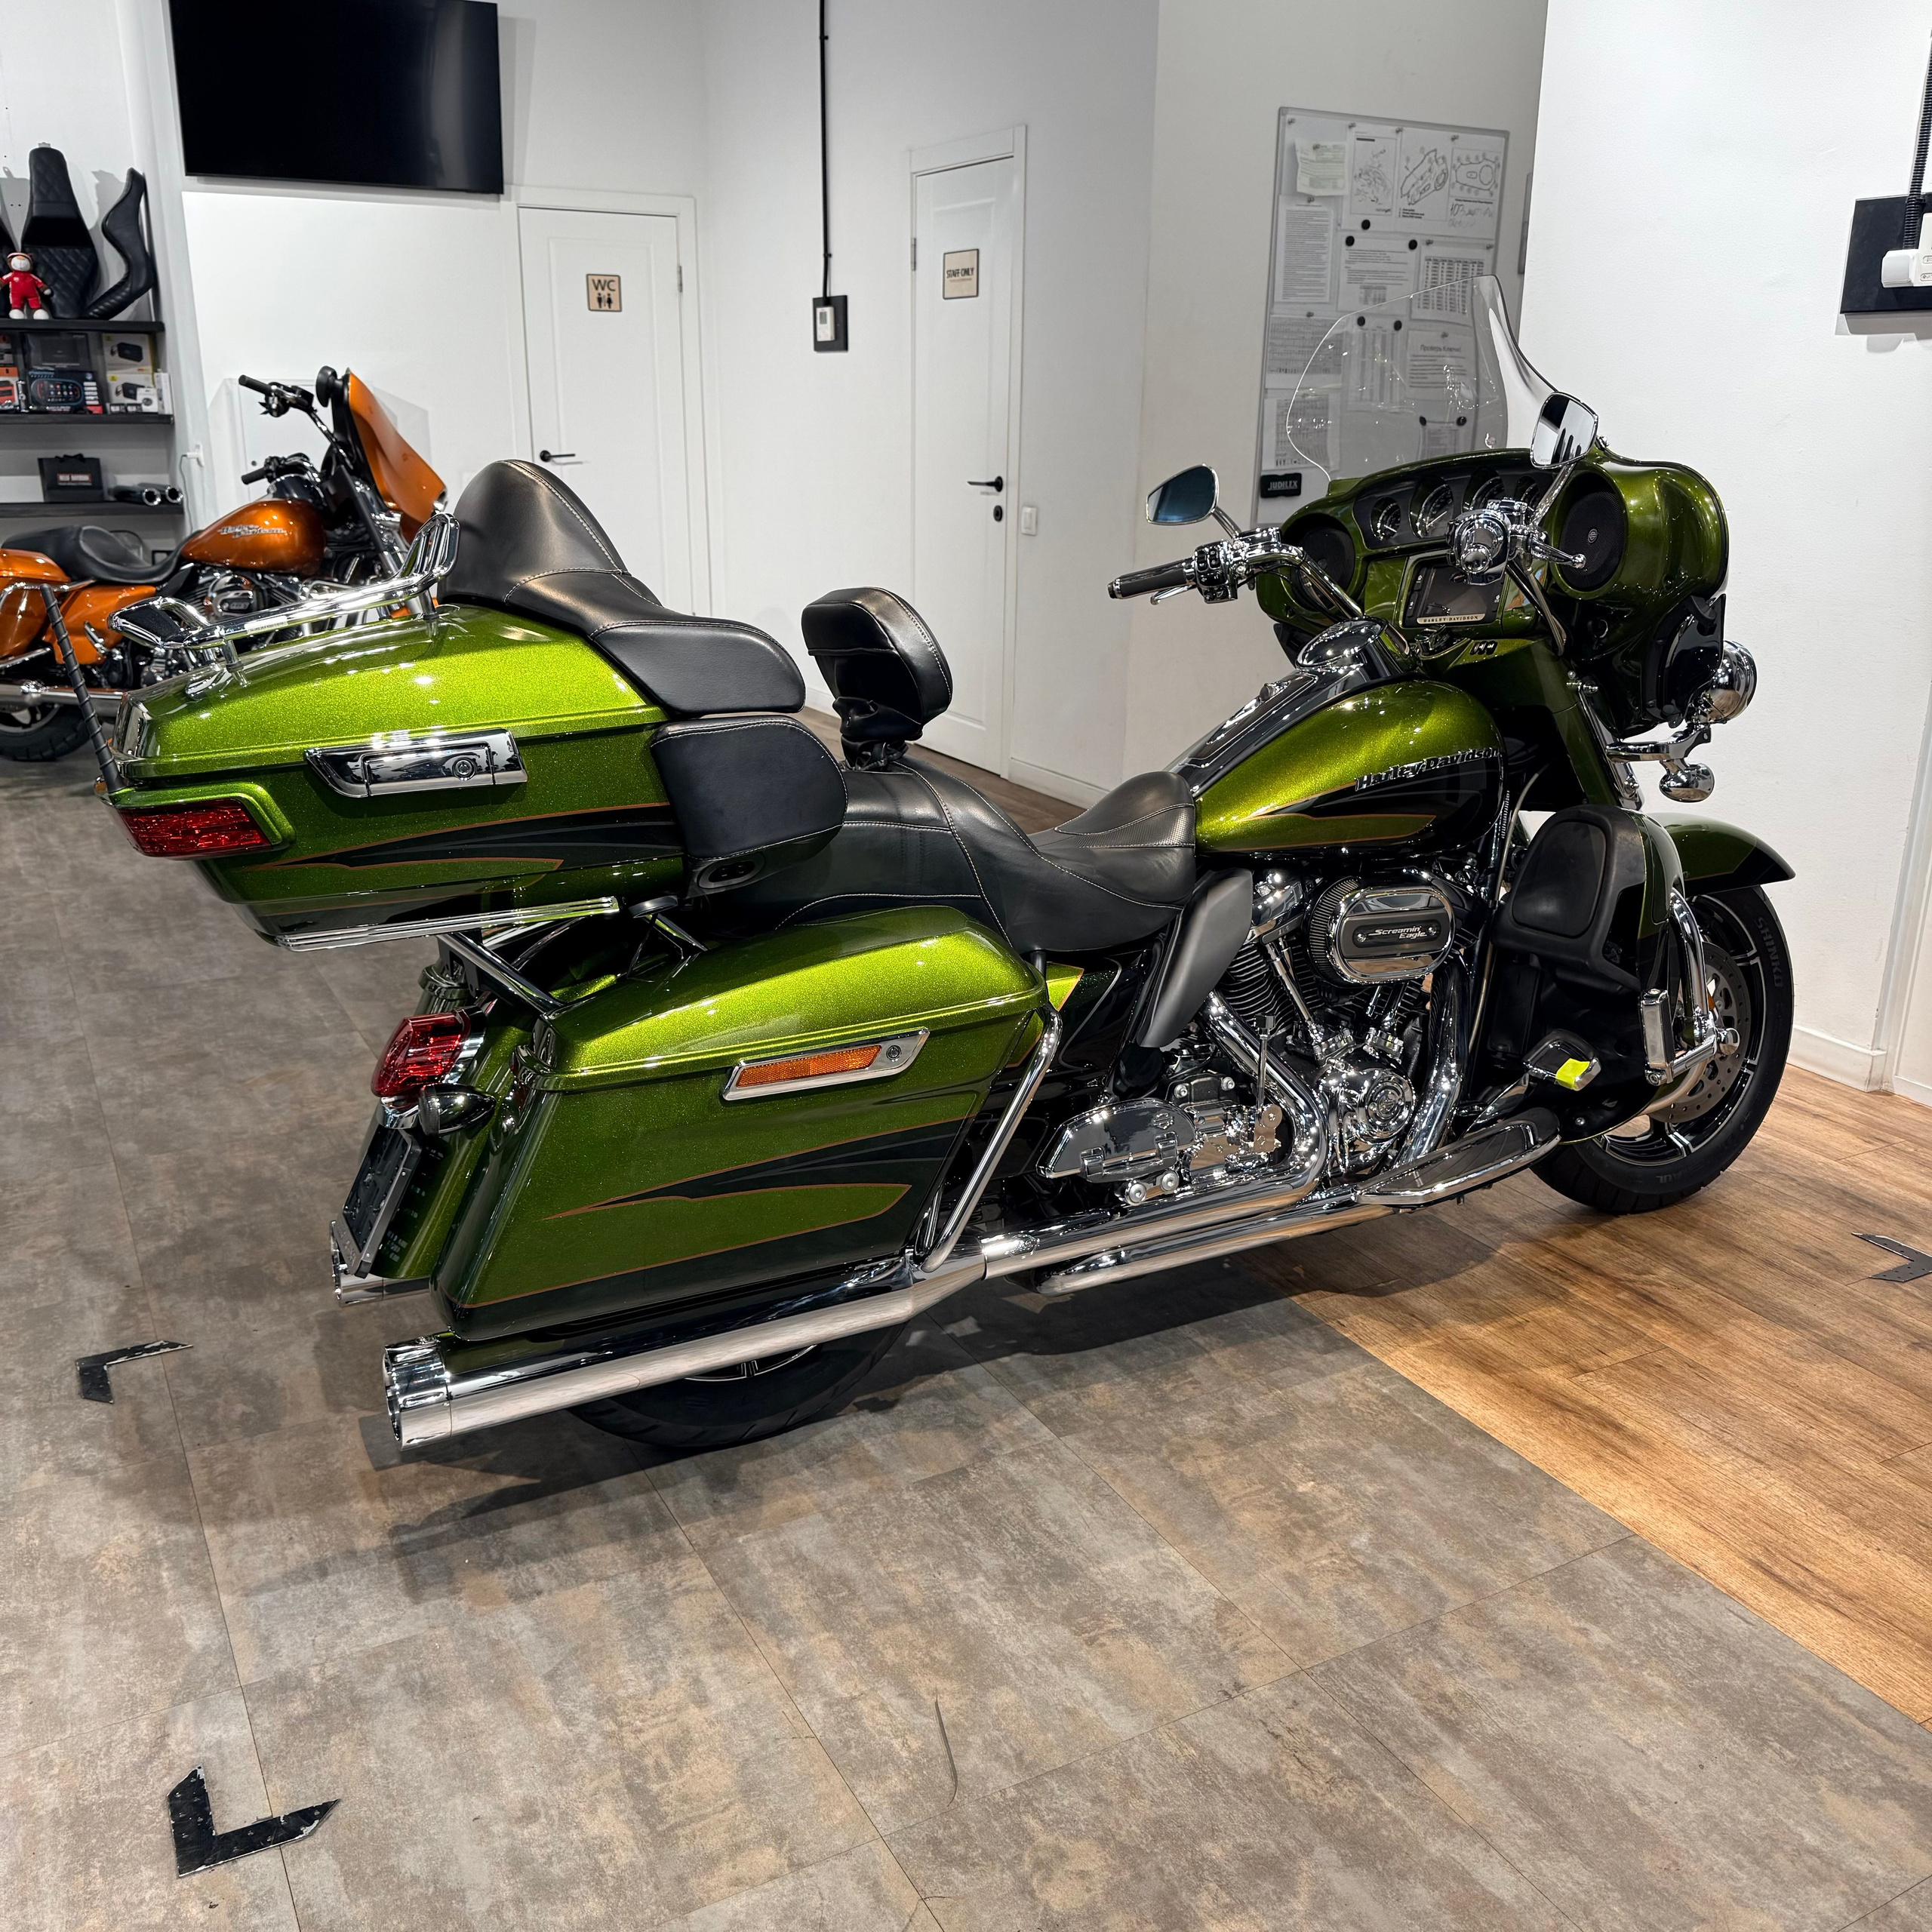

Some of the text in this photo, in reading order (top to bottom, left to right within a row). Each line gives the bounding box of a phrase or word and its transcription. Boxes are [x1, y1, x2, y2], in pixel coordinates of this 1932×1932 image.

[946, 267, 974, 278] STAFF ONLY
[592, 278, 616, 291] WC
[1398, 931, 1428, 940] Eagle
[1755, 917, 1783, 987] SHINKO
